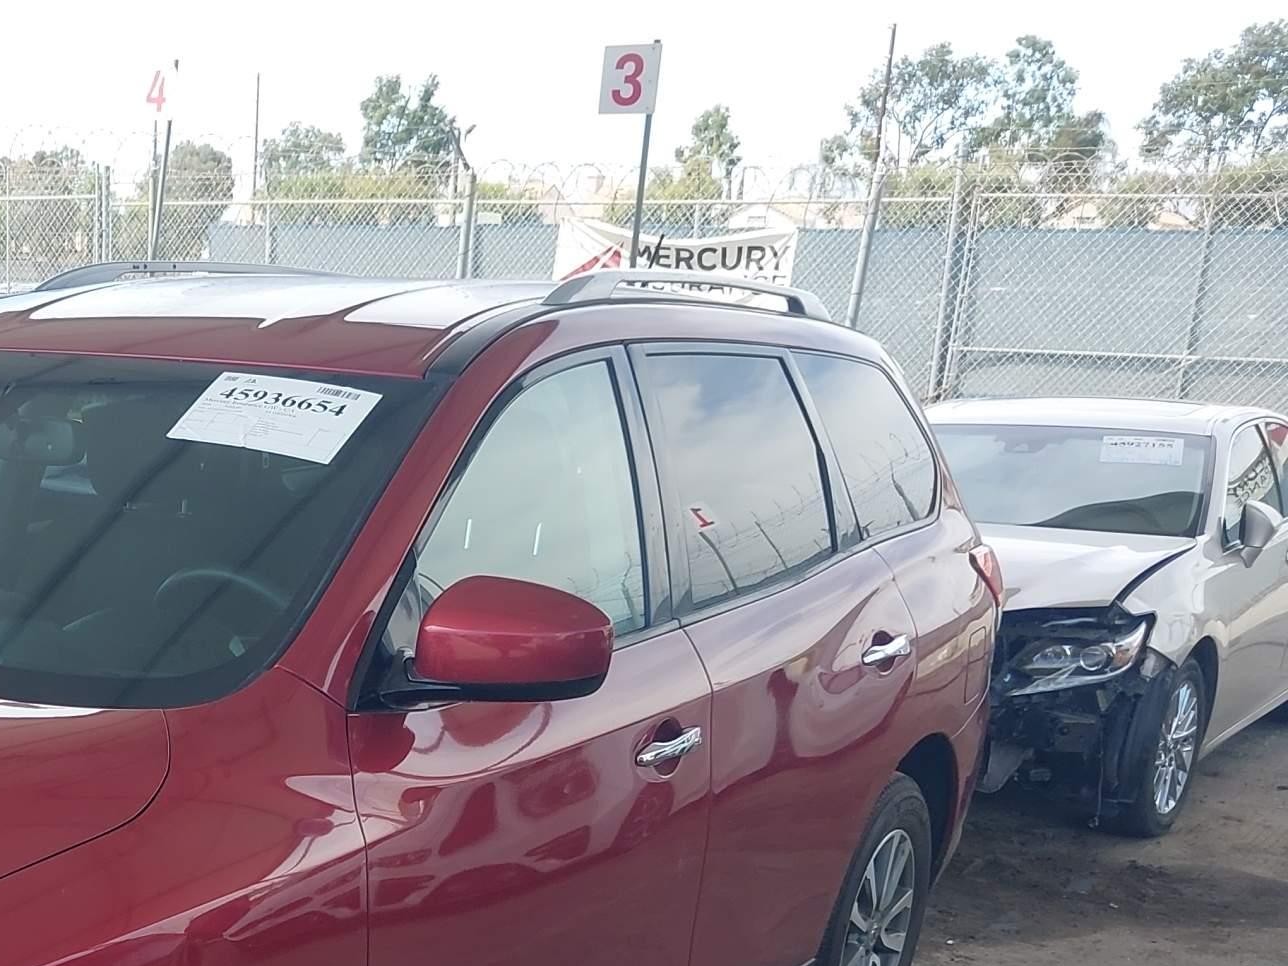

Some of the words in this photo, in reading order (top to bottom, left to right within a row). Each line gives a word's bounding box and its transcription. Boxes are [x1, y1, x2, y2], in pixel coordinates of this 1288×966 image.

[146, 70, 167, 113] 4
[611, 52, 644, 106] 3
[637, 244, 791, 271] MERCURY
[626, 275, 787, 296] RANCE
[219, 386, 348, 417] 45936654
